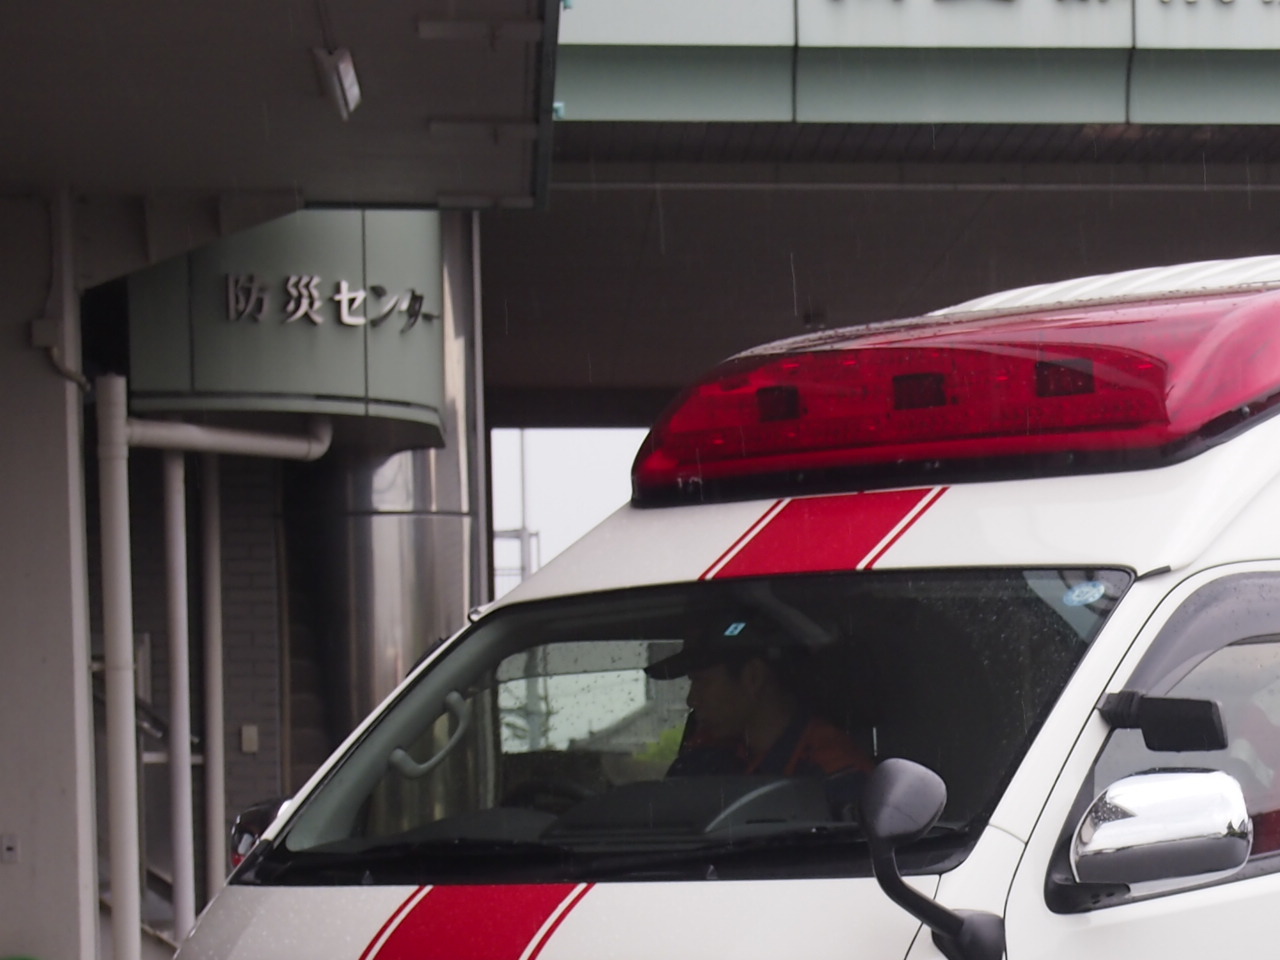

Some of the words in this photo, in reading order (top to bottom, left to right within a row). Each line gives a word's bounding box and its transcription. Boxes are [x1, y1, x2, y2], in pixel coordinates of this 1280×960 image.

[225, 273, 440, 333] 防災センター
